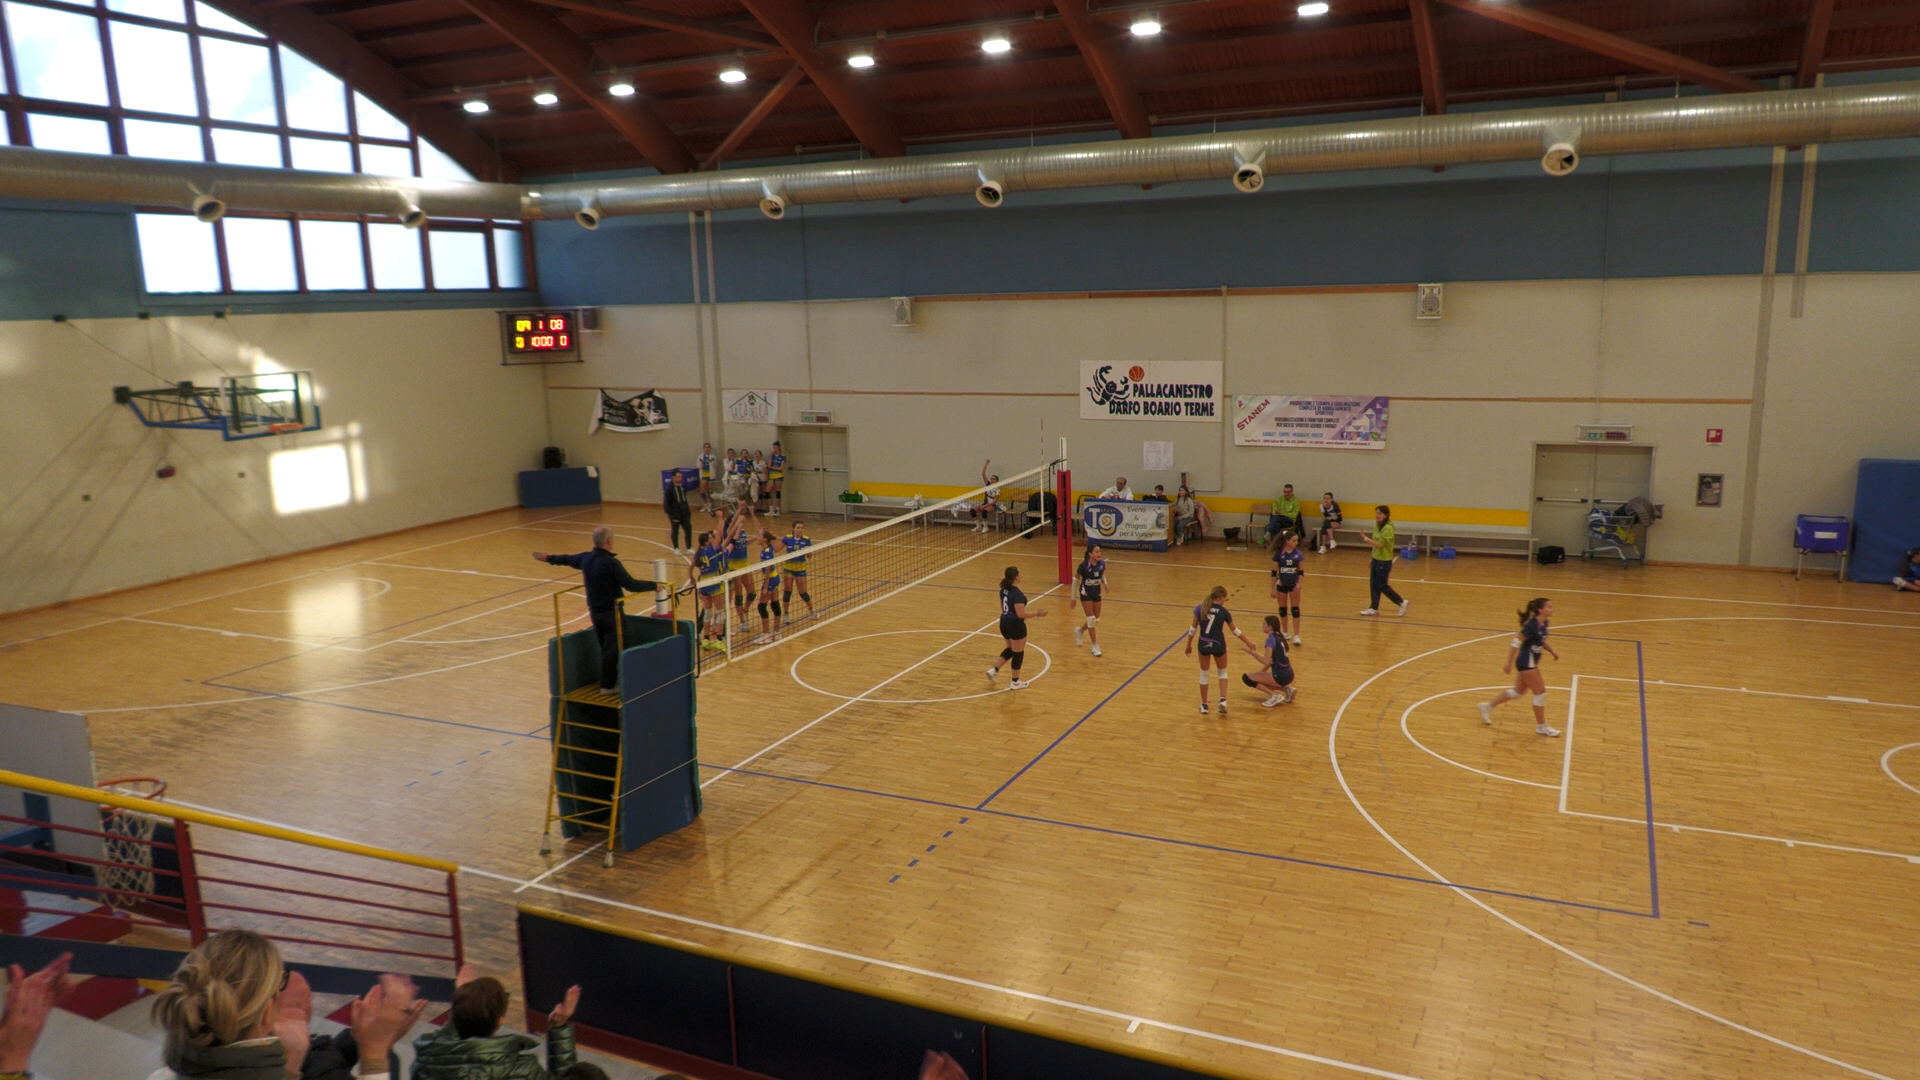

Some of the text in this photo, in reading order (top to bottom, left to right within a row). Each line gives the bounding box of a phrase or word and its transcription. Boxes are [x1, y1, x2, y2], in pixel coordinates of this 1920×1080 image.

[550, 319, 564, 330] 08
[560, 335, 568, 346] 0
[1133, 383, 1213, 399] PALLACANESTRO
[1108, 401, 1215, 417] DARFO BOARIO TERME
[1236, 399, 1271, 431] STANEM
[1003, 596, 1009, 612] 6
[1205, 614, 1216, 634] 7
